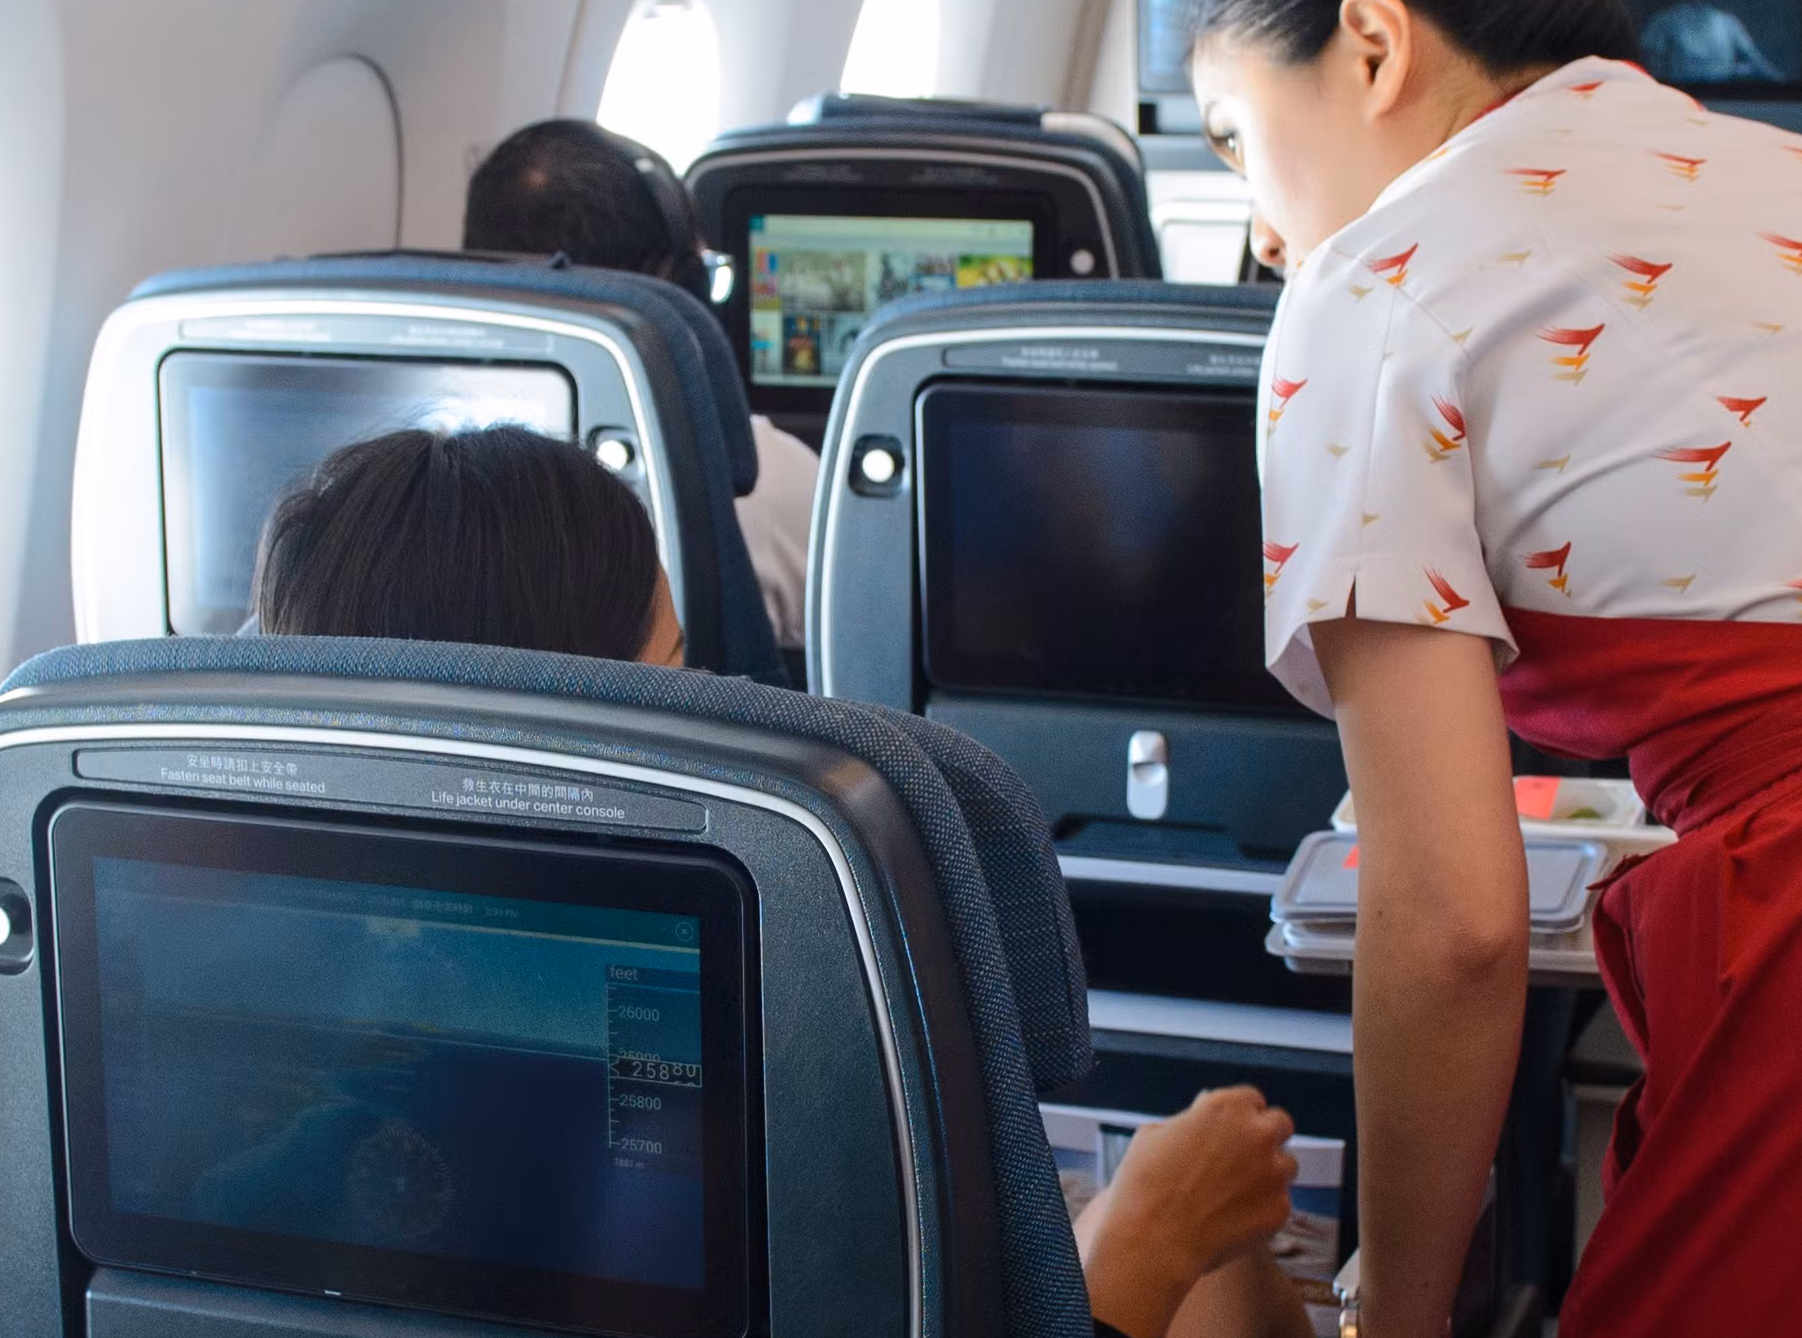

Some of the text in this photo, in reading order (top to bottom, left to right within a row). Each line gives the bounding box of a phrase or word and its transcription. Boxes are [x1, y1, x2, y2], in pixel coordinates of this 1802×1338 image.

[186, 754, 298, 776] 安坐時請扣上安全帶
[160, 767, 326, 794] Fasten seat belt while seated
[431, 791, 626, 819] Life jacket under center console
[610, 965, 638, 981] feet
[618, 1005, 660, 1022] 26000
[619, 1093, 662, 1110] 25800
[620, 1138, 662, 1154] 25700
